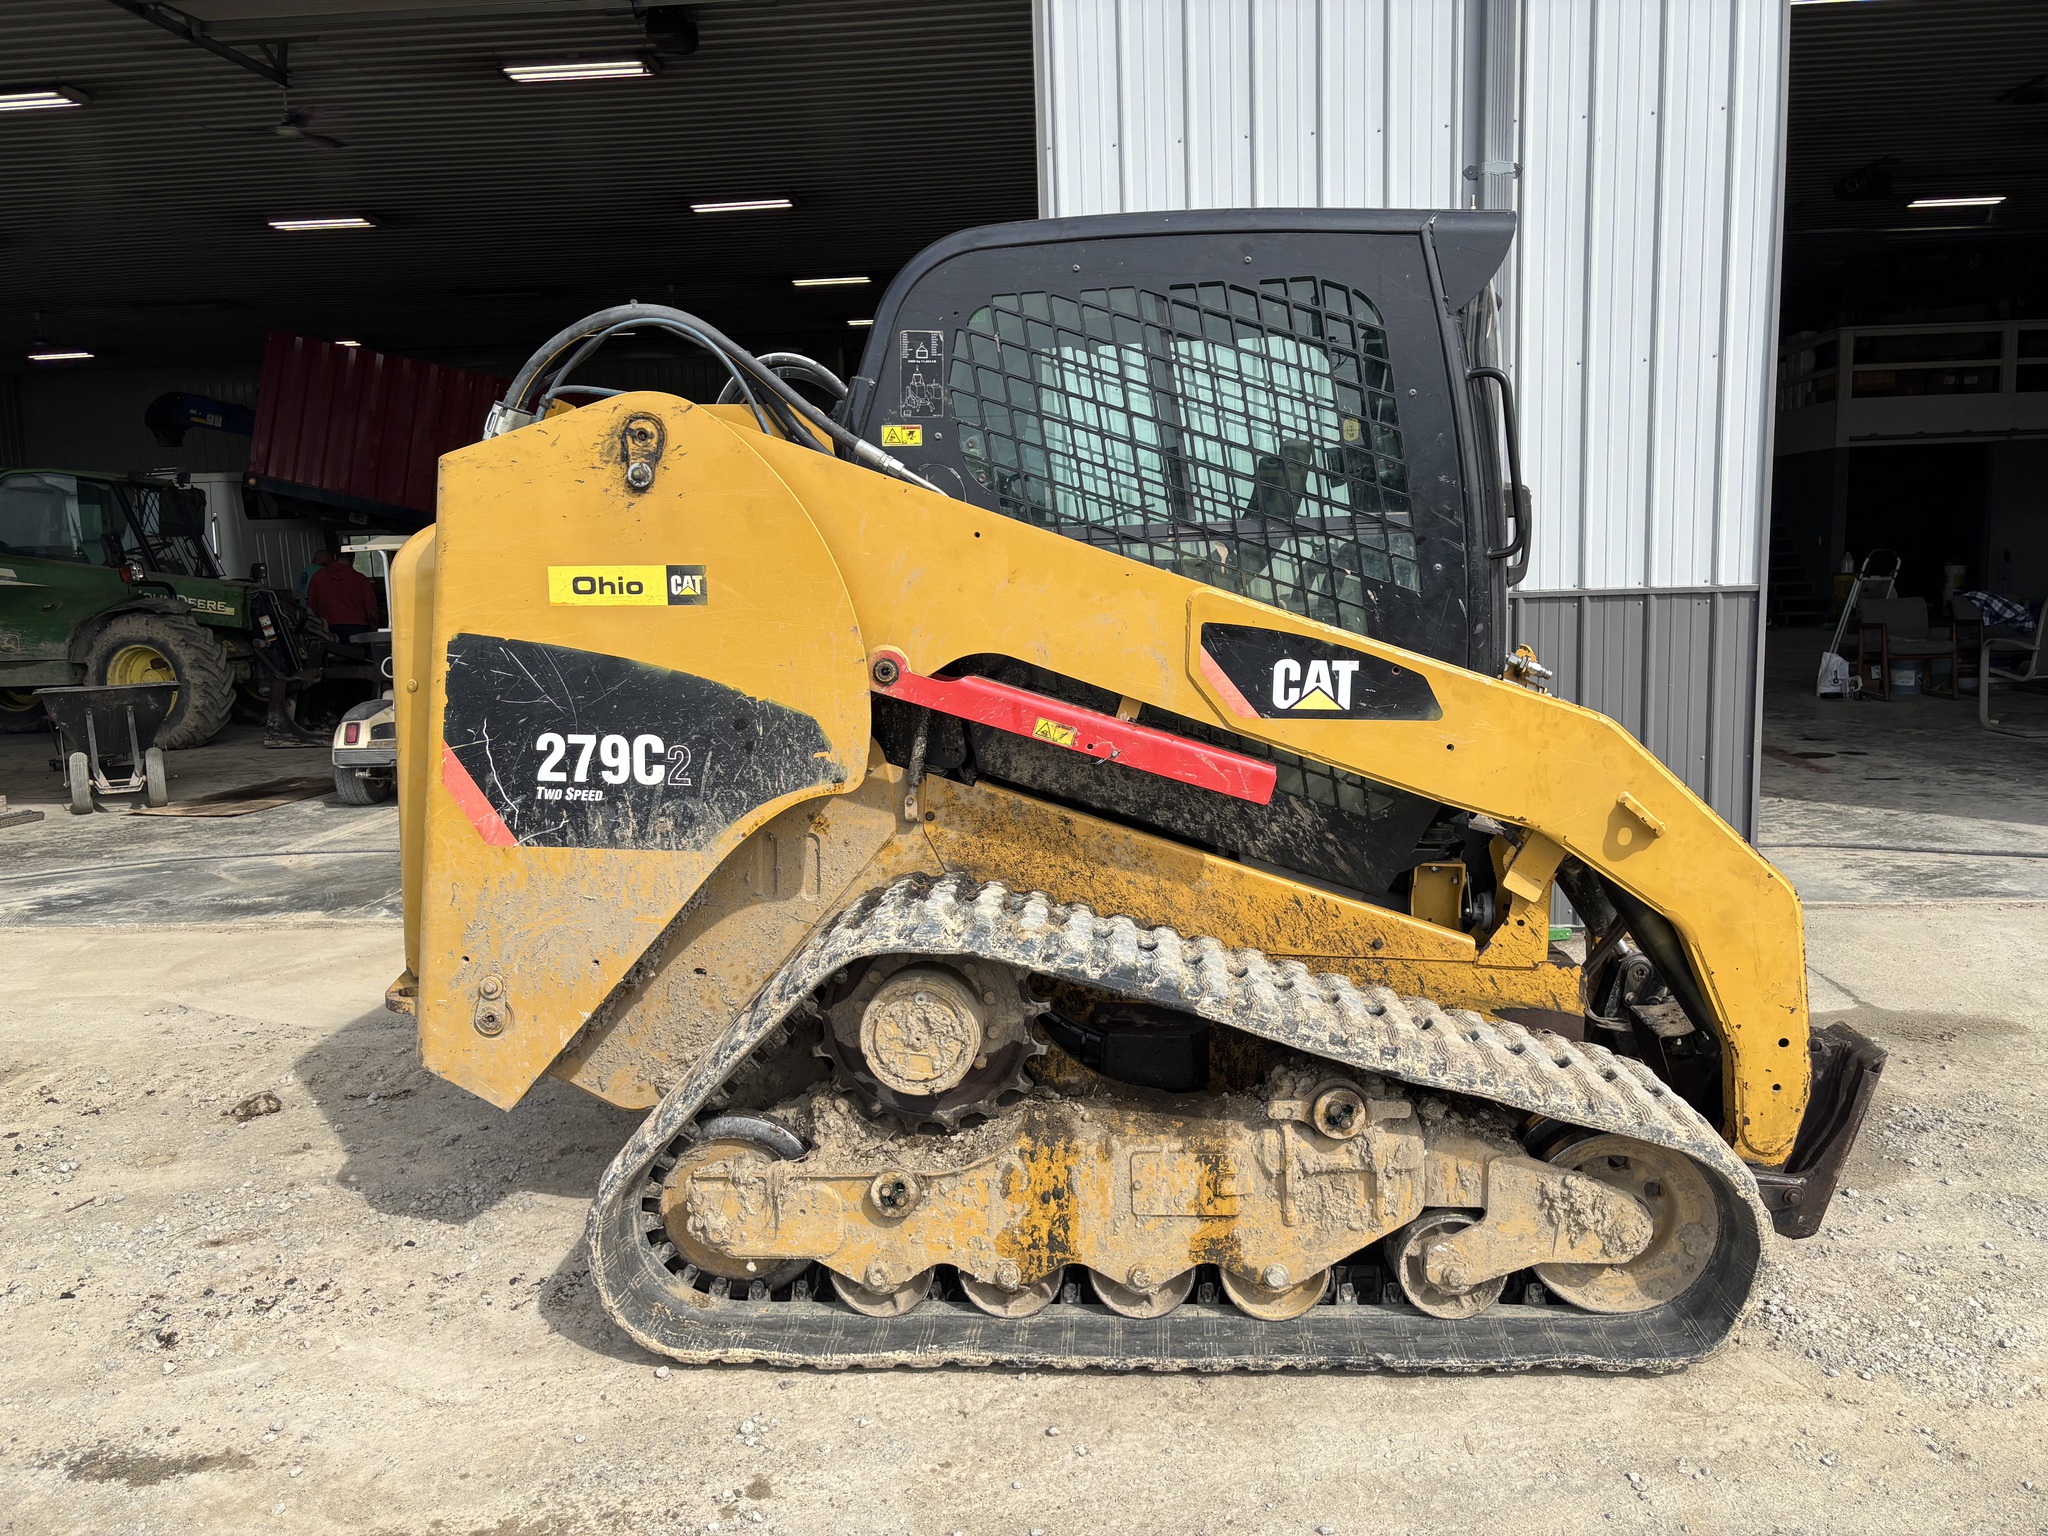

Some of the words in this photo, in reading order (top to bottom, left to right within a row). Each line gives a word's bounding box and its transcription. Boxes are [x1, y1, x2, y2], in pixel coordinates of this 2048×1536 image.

[572, 576, 644, 595] Ohio
[670, 575, 703, 596] CAT
[1272, 658, 1360, 711] CAT
